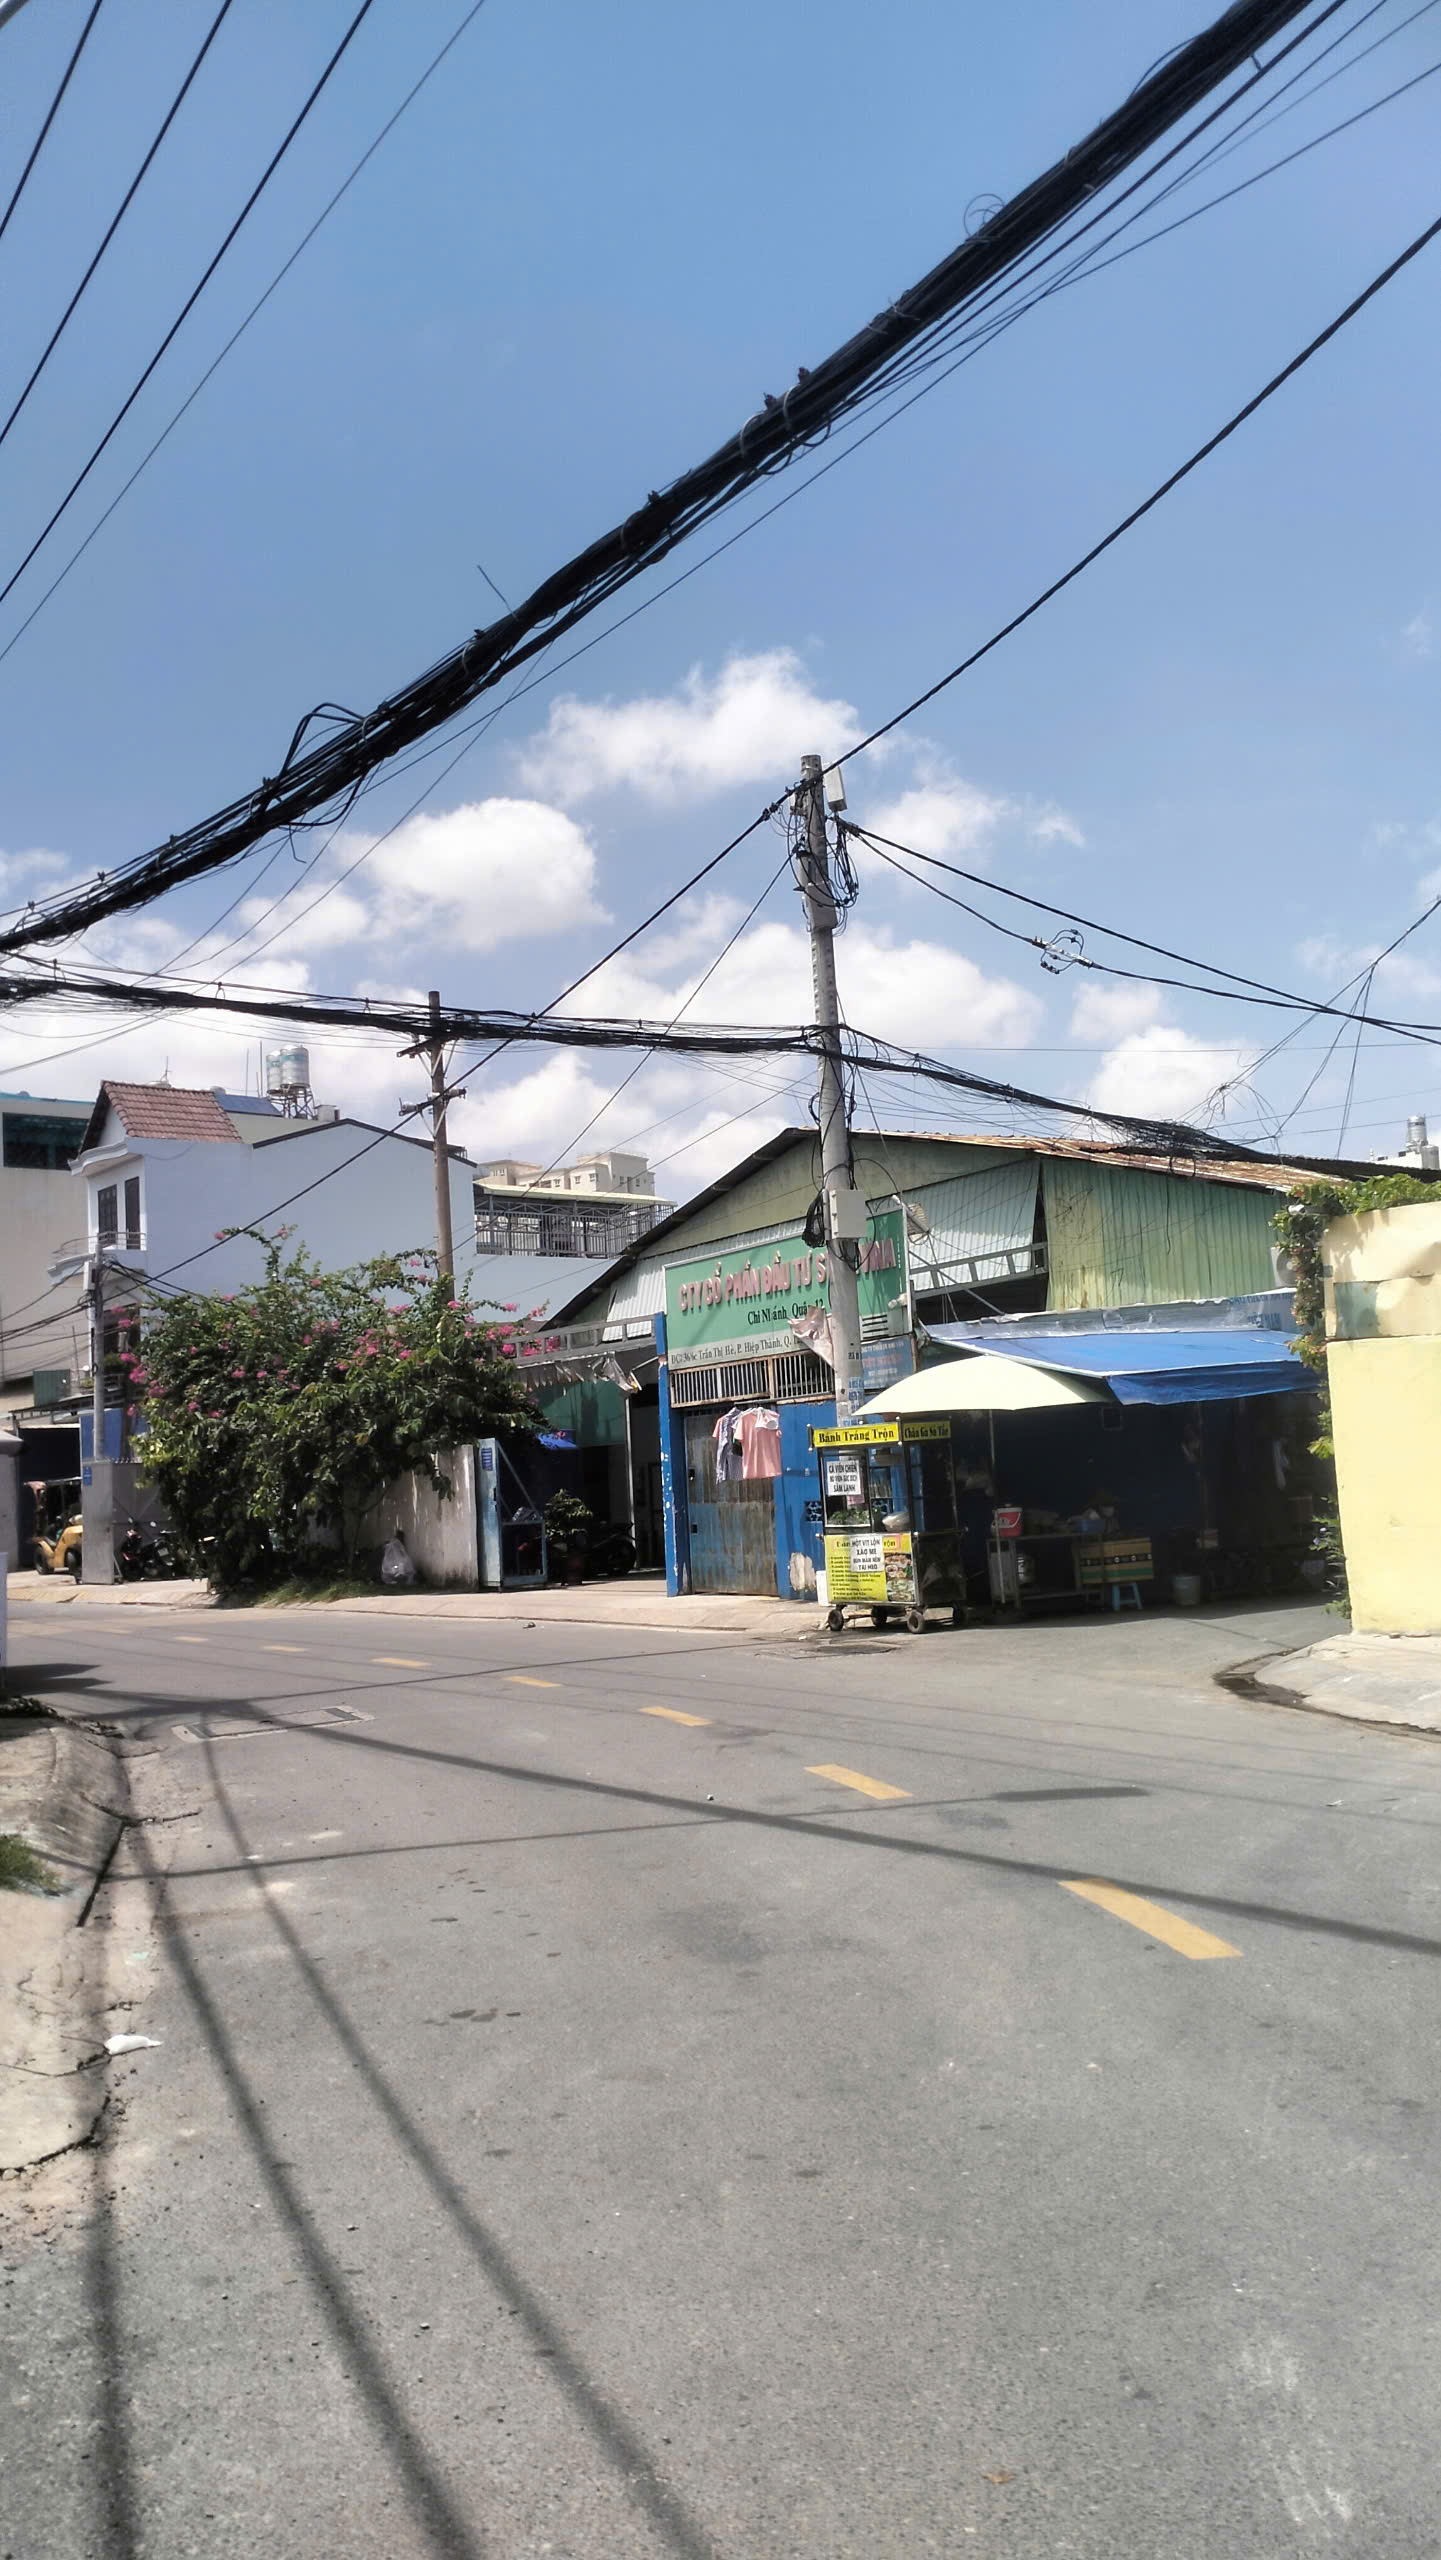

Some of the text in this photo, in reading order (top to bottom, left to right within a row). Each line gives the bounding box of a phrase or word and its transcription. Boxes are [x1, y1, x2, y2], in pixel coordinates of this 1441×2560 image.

[678, 1282, 703, 1312] CTY
[703, 1261, 722, 1305] CỔ
[792, 1249, 812, 1287] TƯ
[748, 1310, 760, 1325] Chi
[783, 1335, 792, 1348] Q.
[818, 1426, 895, 1443] Bánh Tráng Trộn
